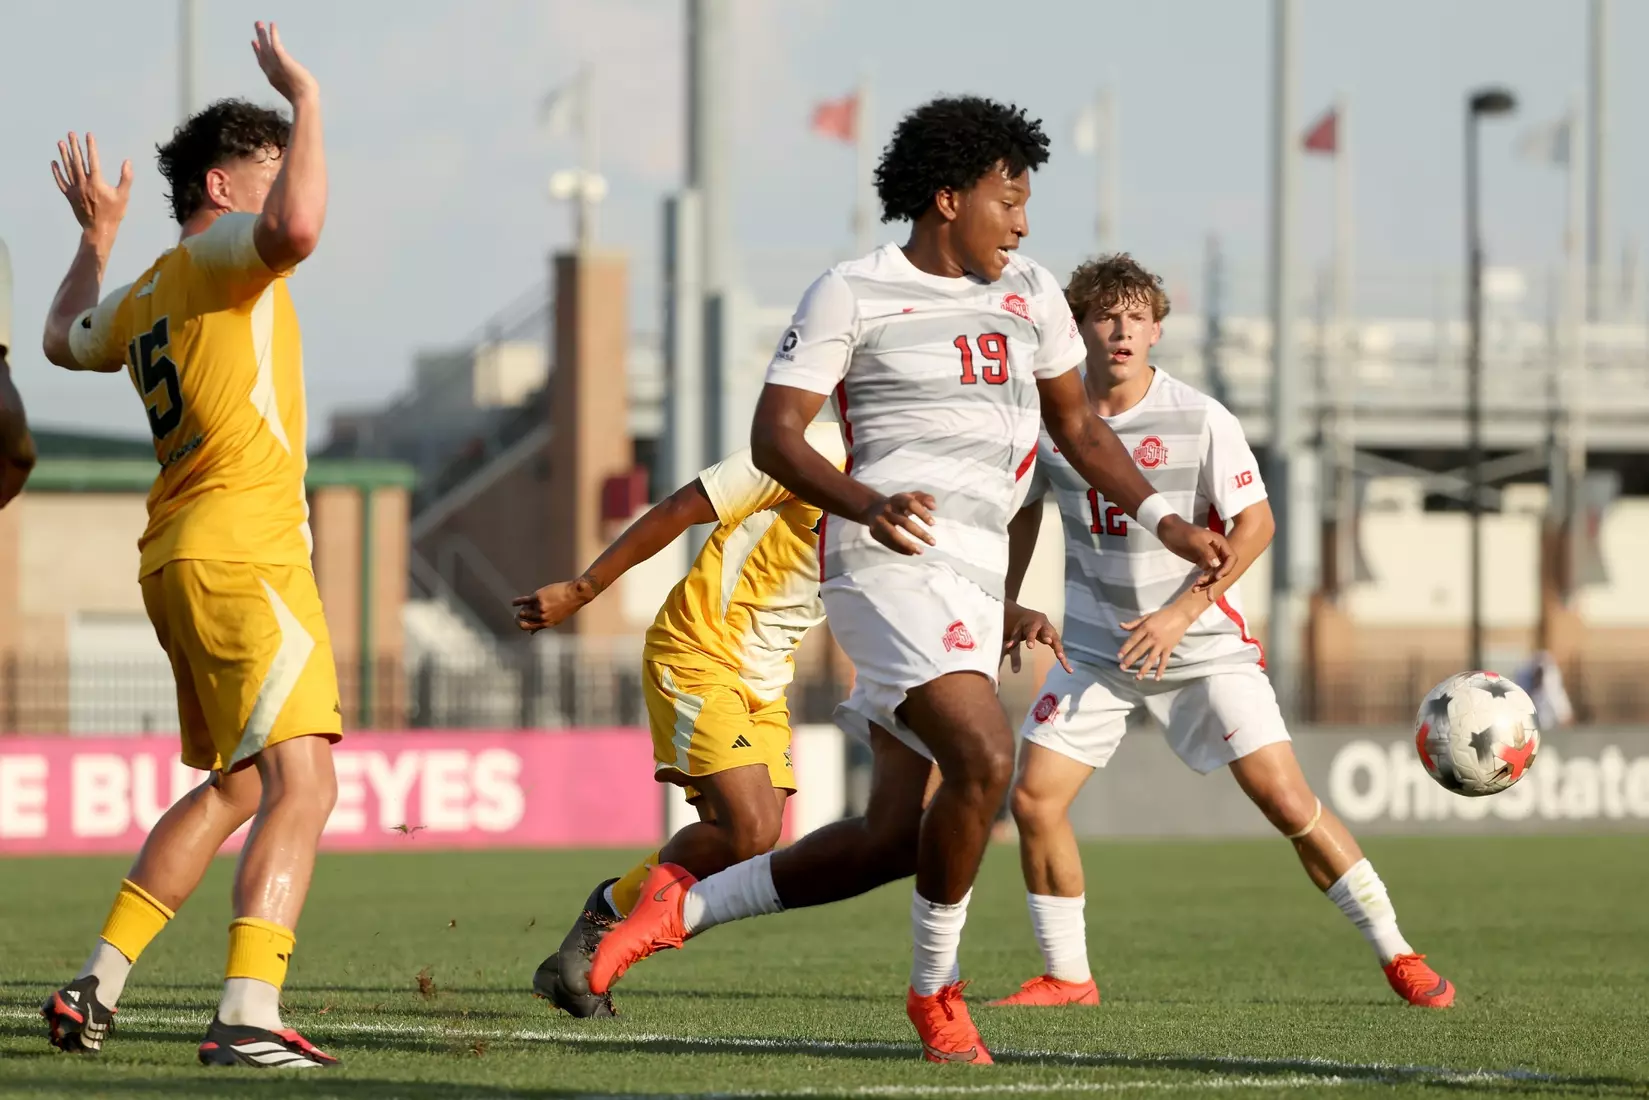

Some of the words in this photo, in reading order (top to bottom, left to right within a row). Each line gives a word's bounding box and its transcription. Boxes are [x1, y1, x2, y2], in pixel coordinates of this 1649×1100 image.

[127, 314, 184, 441] 15
[953, 332, 1009, 386] 19
[1086, 487, 1128, 537] 12
[71, 749, 526, 838] BUEYES
